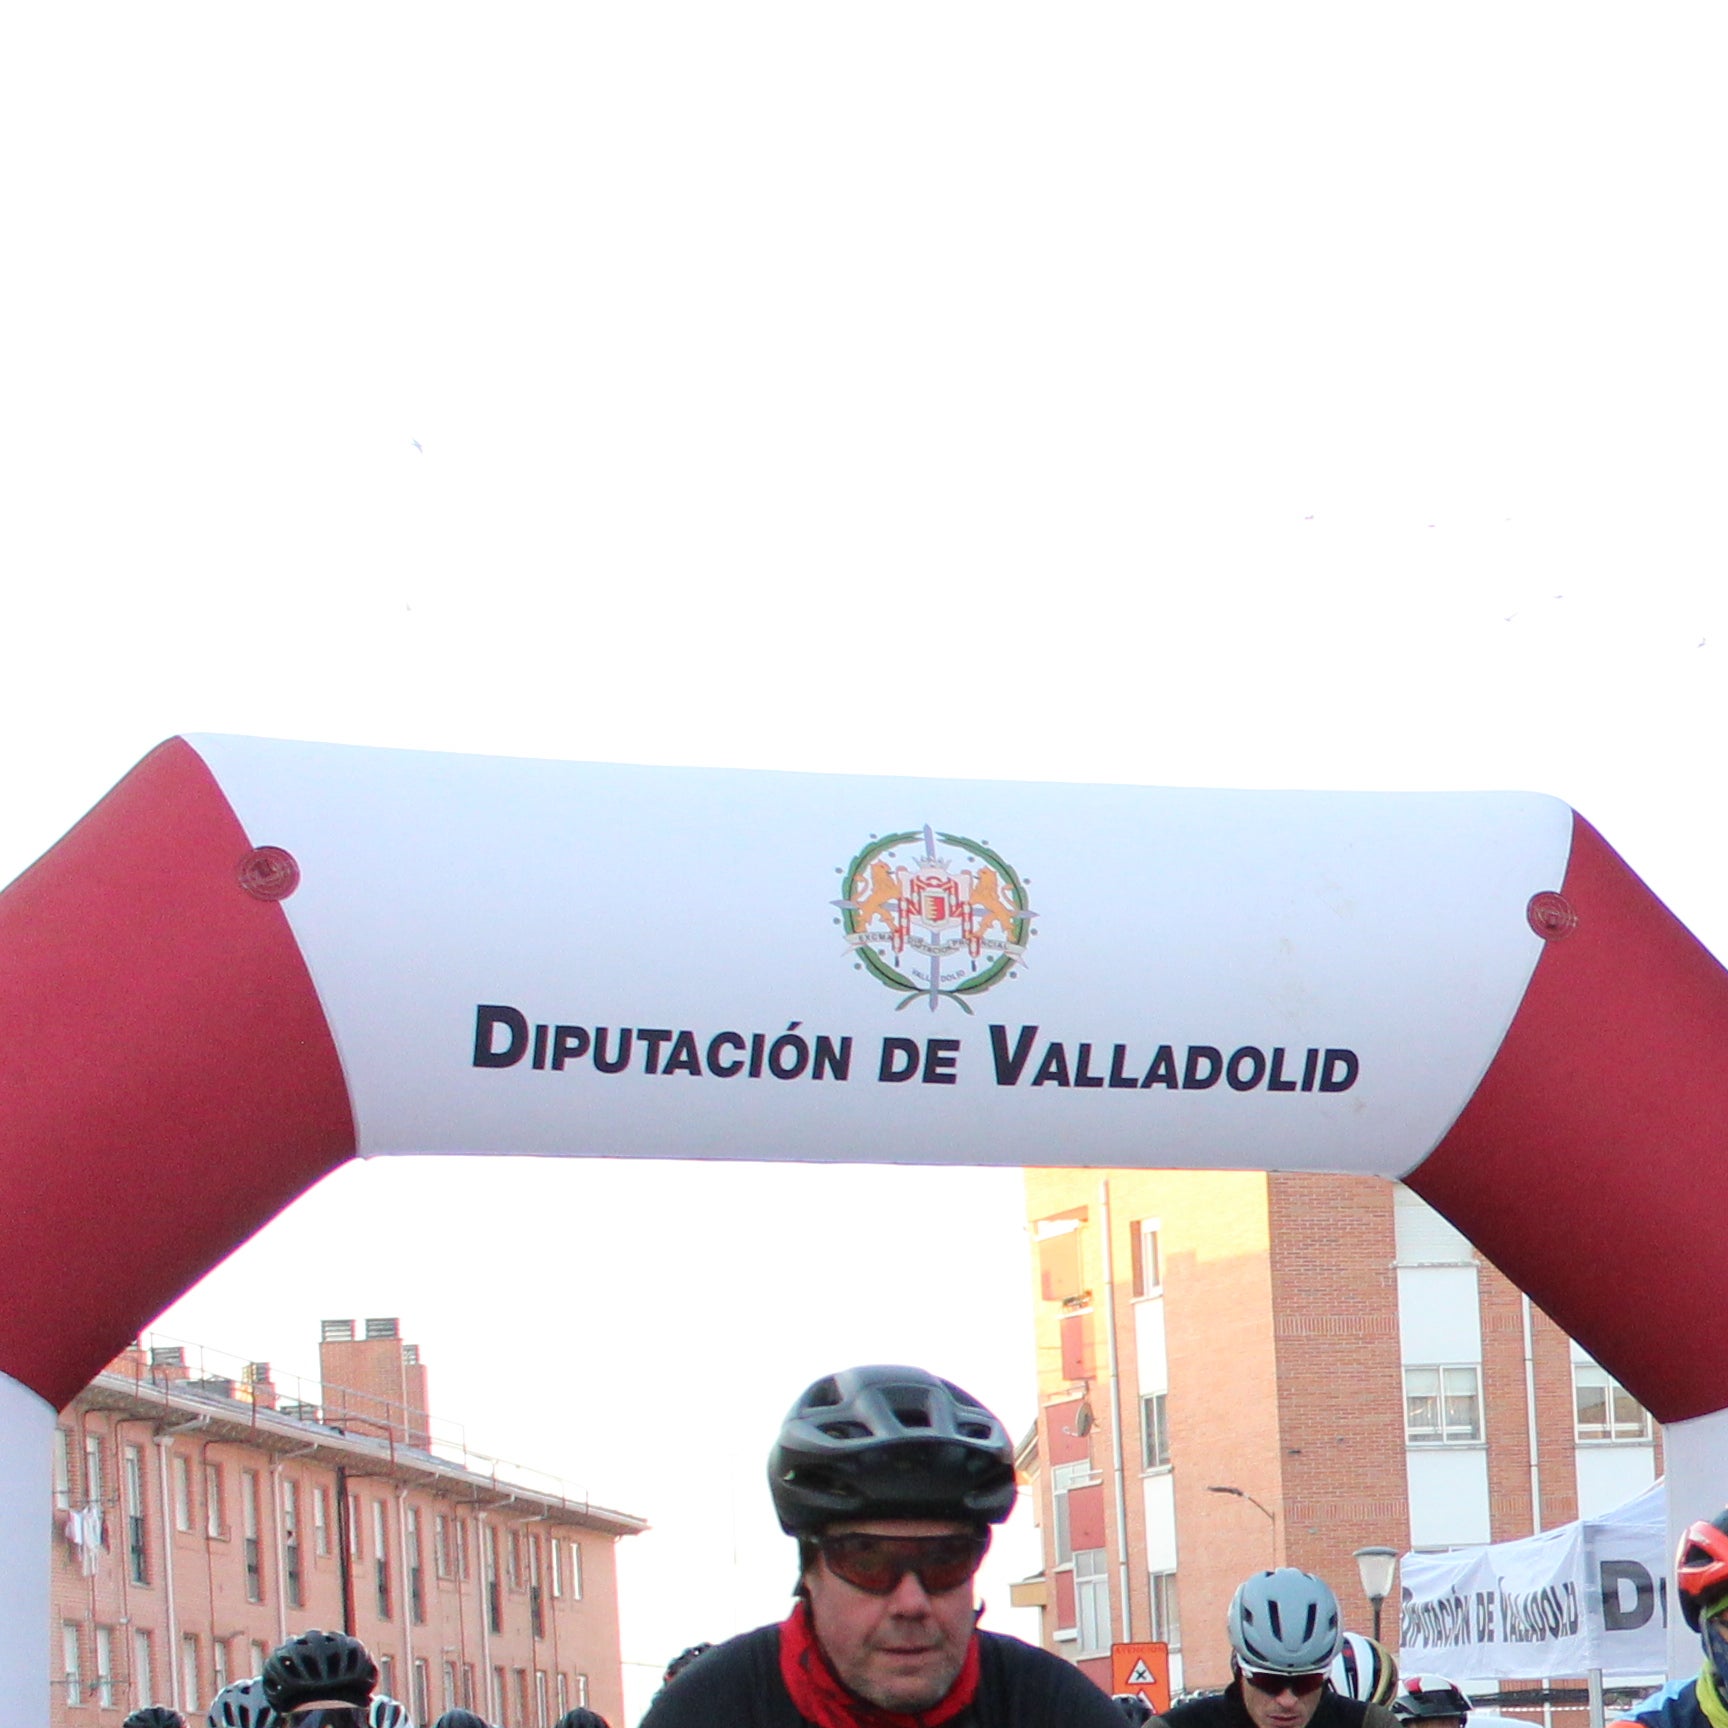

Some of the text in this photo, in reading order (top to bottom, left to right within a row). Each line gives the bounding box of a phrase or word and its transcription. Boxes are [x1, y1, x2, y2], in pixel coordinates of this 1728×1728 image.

[472, 1004, 1360, 1094] DIPUTACIÓN DE VALLADOLID
[1475, 1590, 1495, 1644] DE
